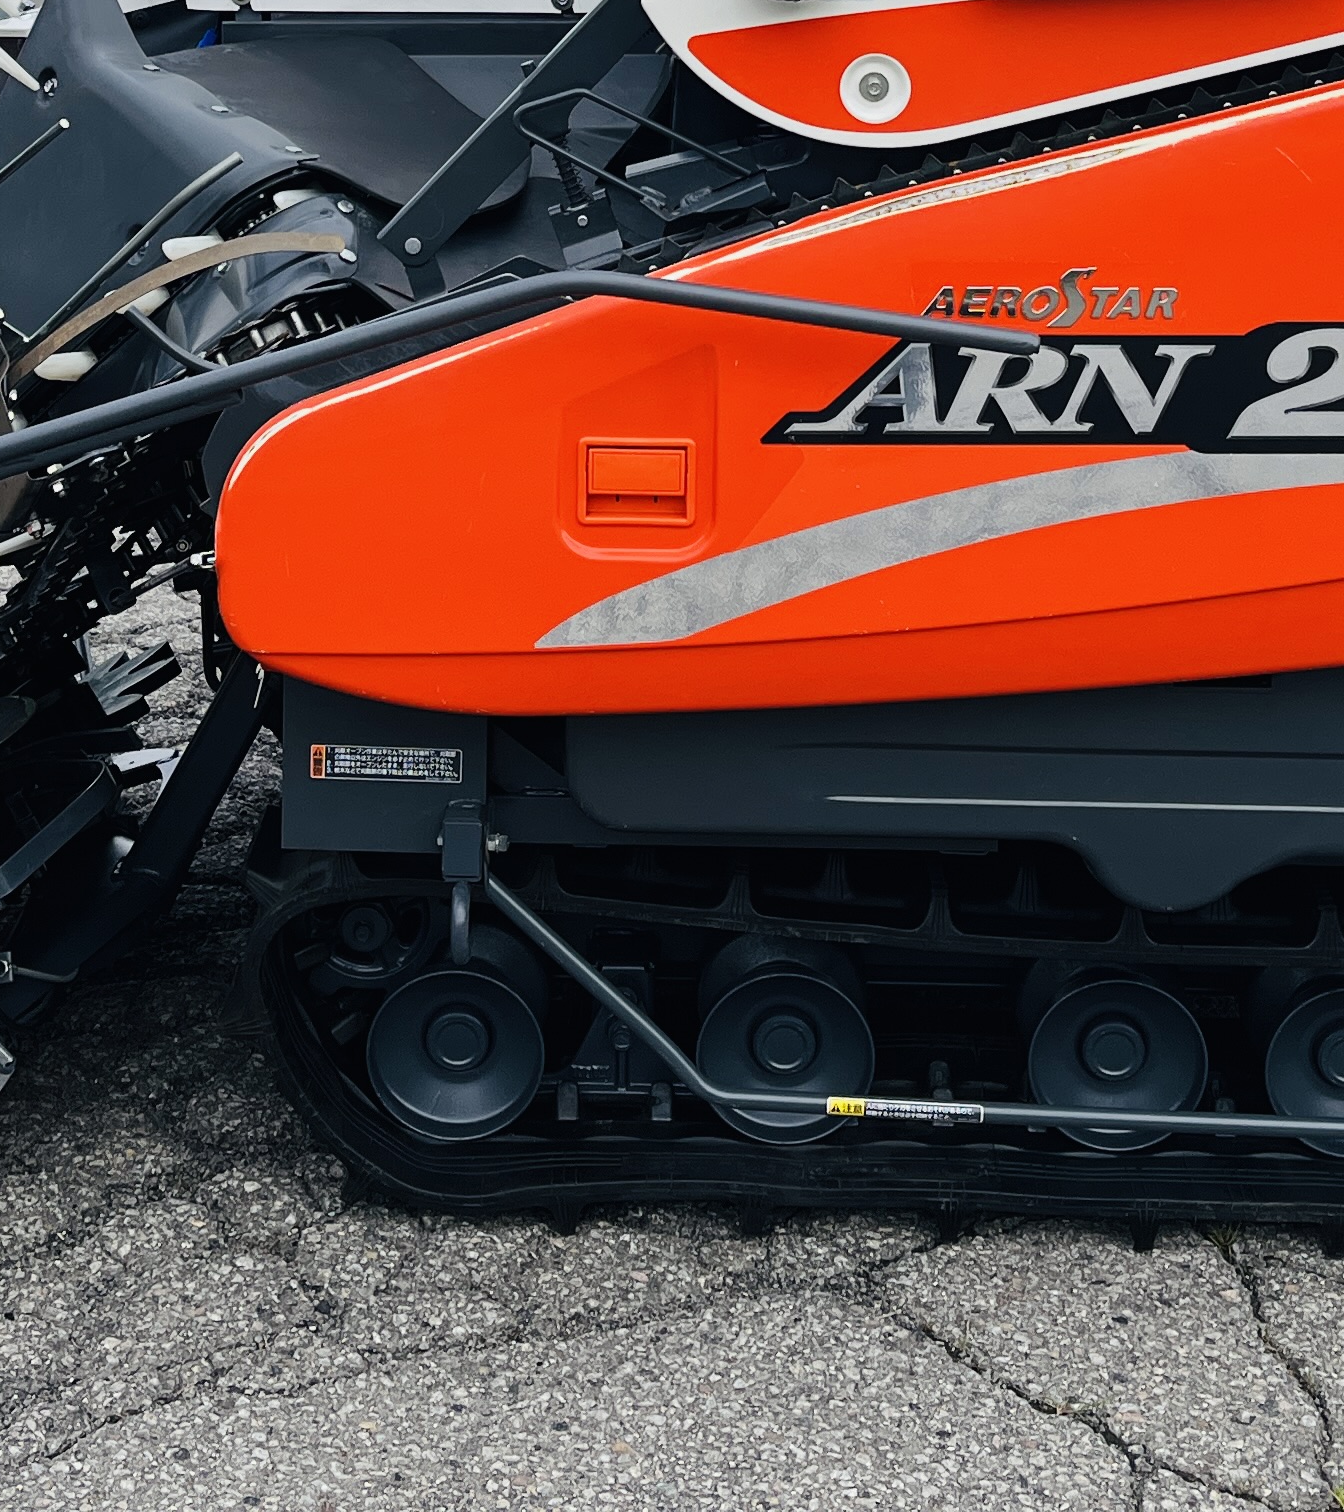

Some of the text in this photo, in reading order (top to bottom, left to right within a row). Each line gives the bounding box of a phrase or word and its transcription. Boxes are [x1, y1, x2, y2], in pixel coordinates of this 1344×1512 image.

[922, 266, 1180, 328] AEROSTAR
[786, 334, 1216, 436] ARN
[843, 1103, 863, 1114] 注意
